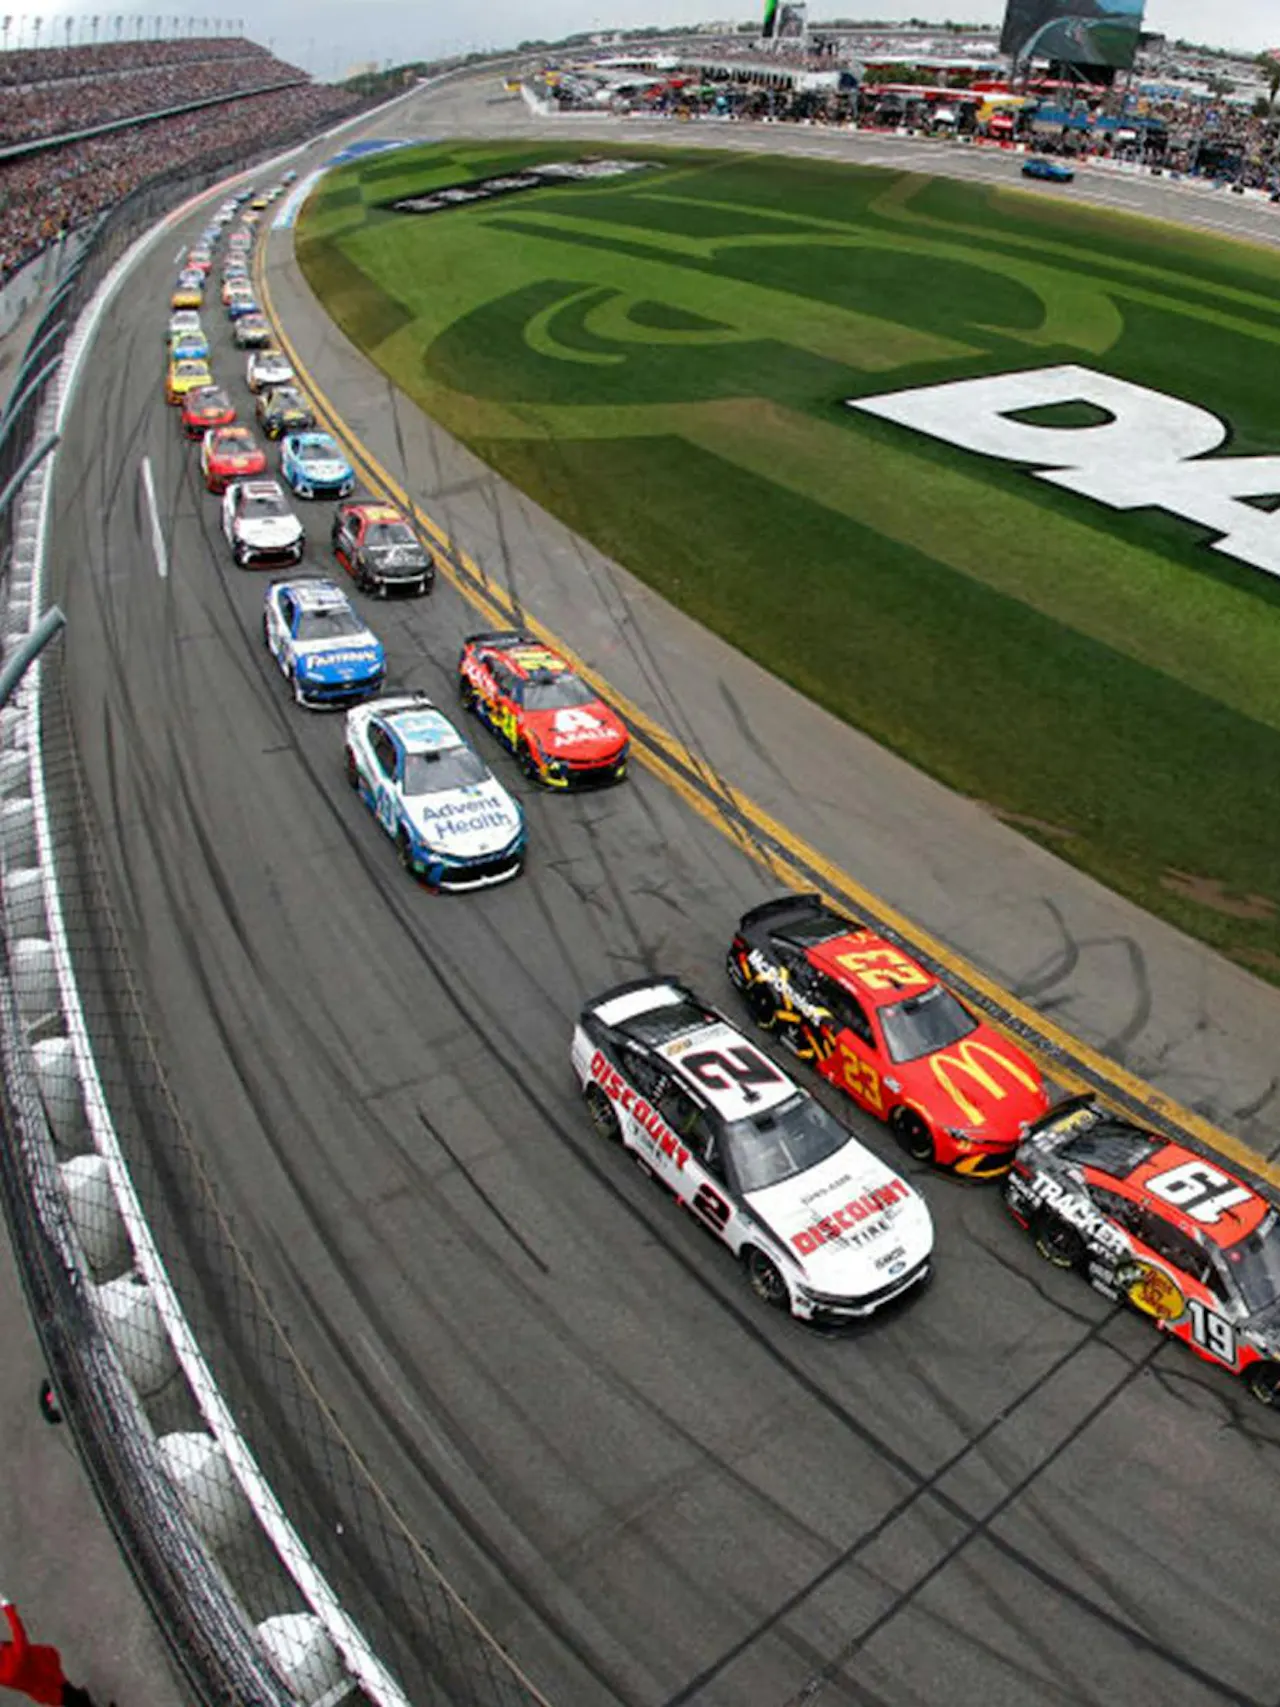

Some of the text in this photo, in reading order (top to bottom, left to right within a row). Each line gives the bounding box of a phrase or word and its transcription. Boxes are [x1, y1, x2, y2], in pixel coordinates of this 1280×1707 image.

[423, 796, 502, 821] Advent
[435, 812, 512, 839] Health
[836, 950, 928, 990] 23
[681, 1046, 784, 1089] 2
[840, 1043, 884, 1110] 23
[591, 1050, 690, 1171] DISCOUNT
[692, 1182, 731, 1232] 2
[790, 1178, 910, 1256] DISCOUNT
[1031, 1170, 1133, 1256] TRACKER
[1145, 1160, 1252, 1224] 19
[852, 1218, 890, 1248] TIRE
[1186, 1298, 1238, 1365] 19
